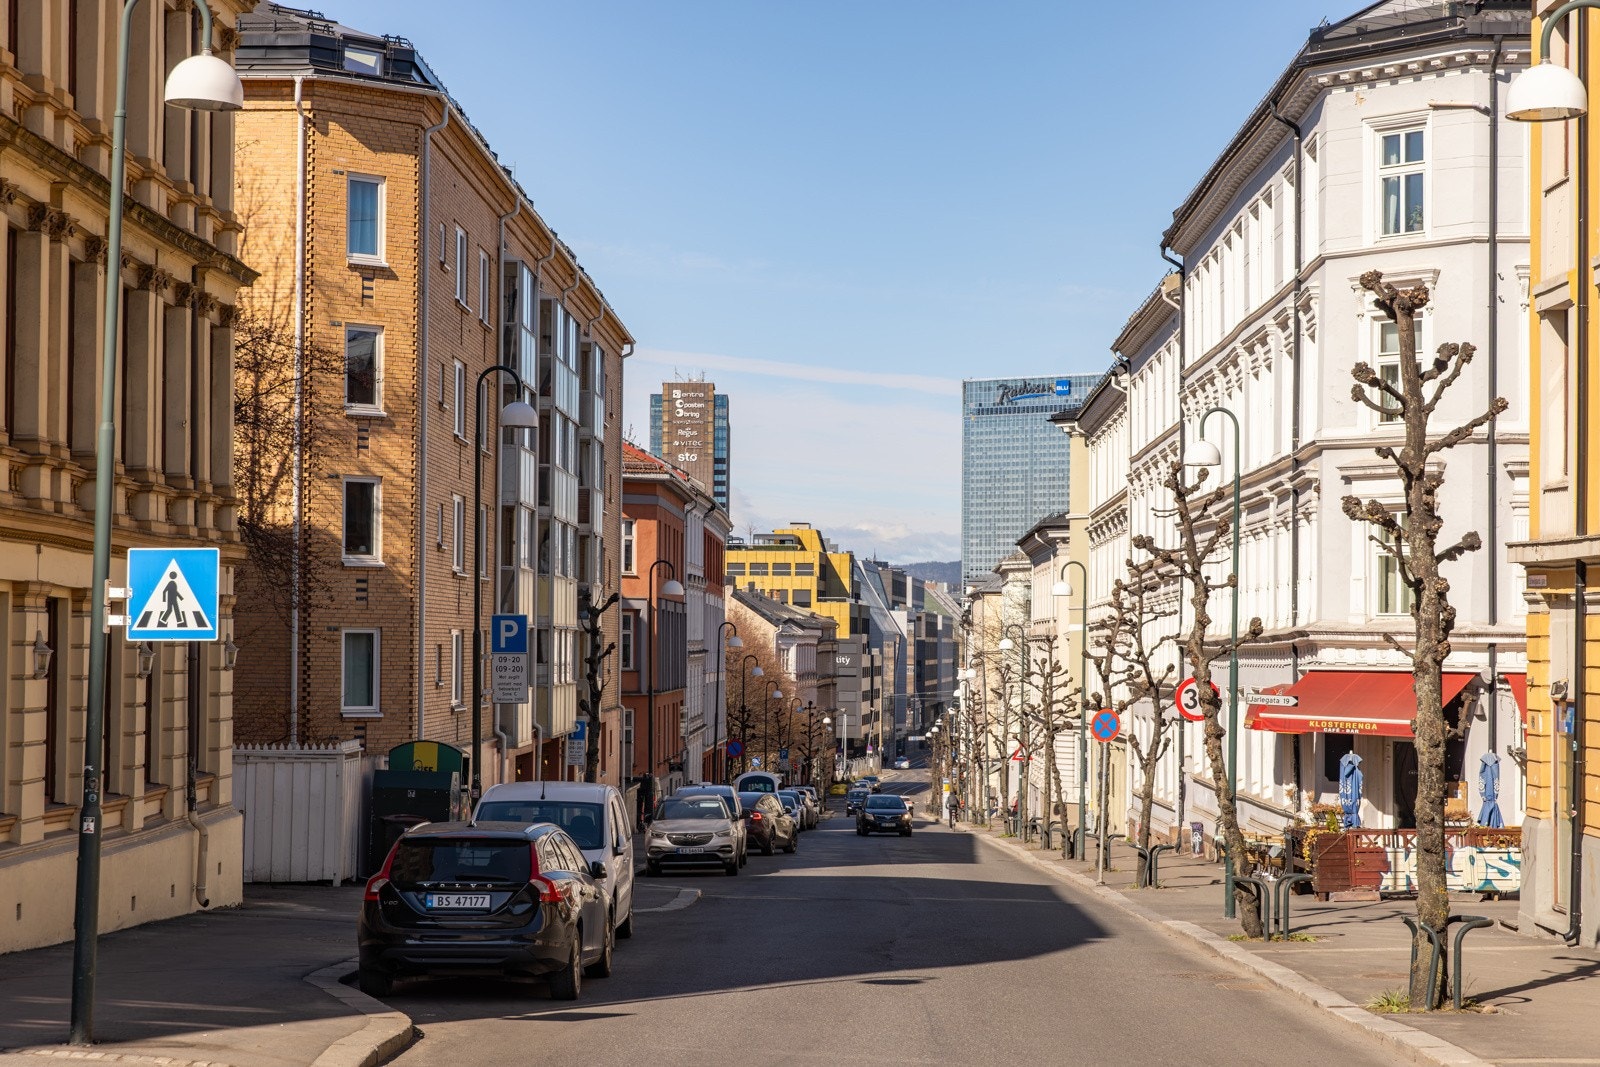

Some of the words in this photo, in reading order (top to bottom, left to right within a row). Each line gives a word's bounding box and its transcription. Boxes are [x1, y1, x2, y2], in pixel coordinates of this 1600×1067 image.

[678, 428, 698, 438] Regus
[500, 619, 519, 649] P
[495, 665, 524, 673] (09-20)
[1249, 696, 1280, 704] Jarlegata
[1309, 720, 1378, 730] KLOSTERENGA
[437, 896, 451, 907] BS
[455, 896, 486, 907] 47177
